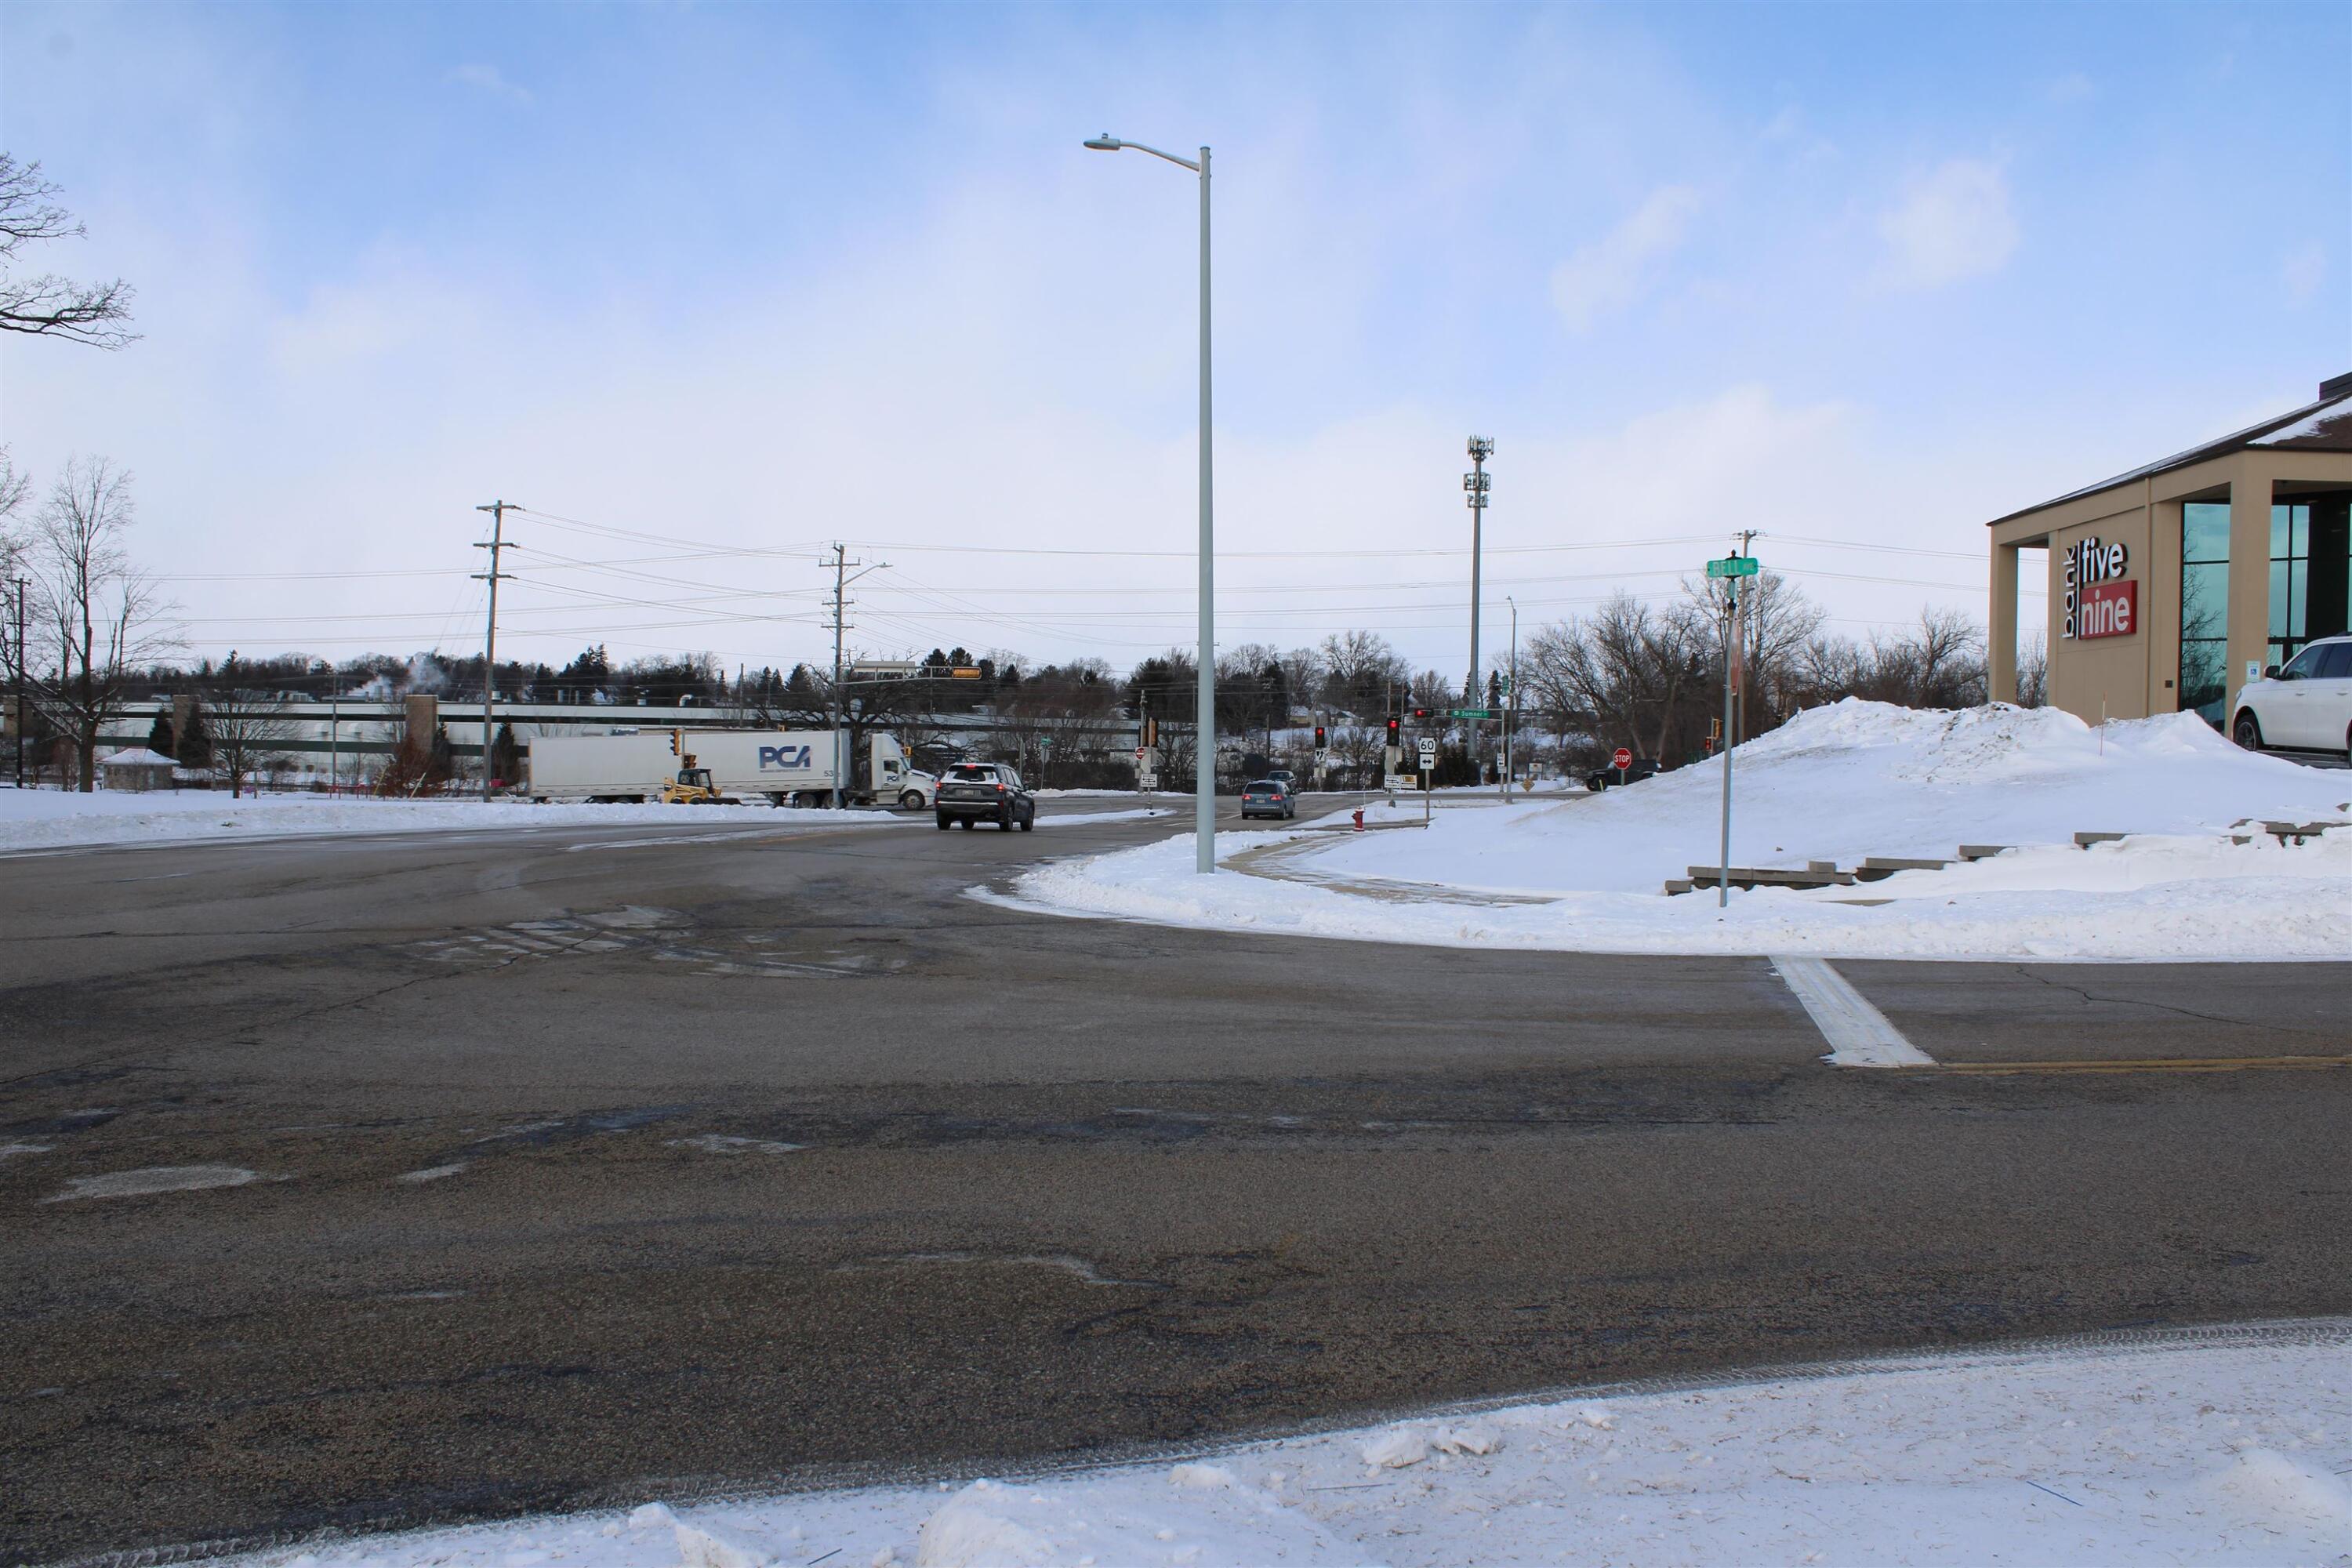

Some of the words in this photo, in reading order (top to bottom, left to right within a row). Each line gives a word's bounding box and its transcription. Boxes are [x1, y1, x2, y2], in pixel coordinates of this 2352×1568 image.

[1713, 561, 1740, 575] BELL
[2082, 537, 2123, 583] five
[2062, 548, 2075, 637] bank
[2081, 589, 2130, 636] nine
[759, 746, 811, 768] PCA
[1421, 740, 1434, 750] 60
